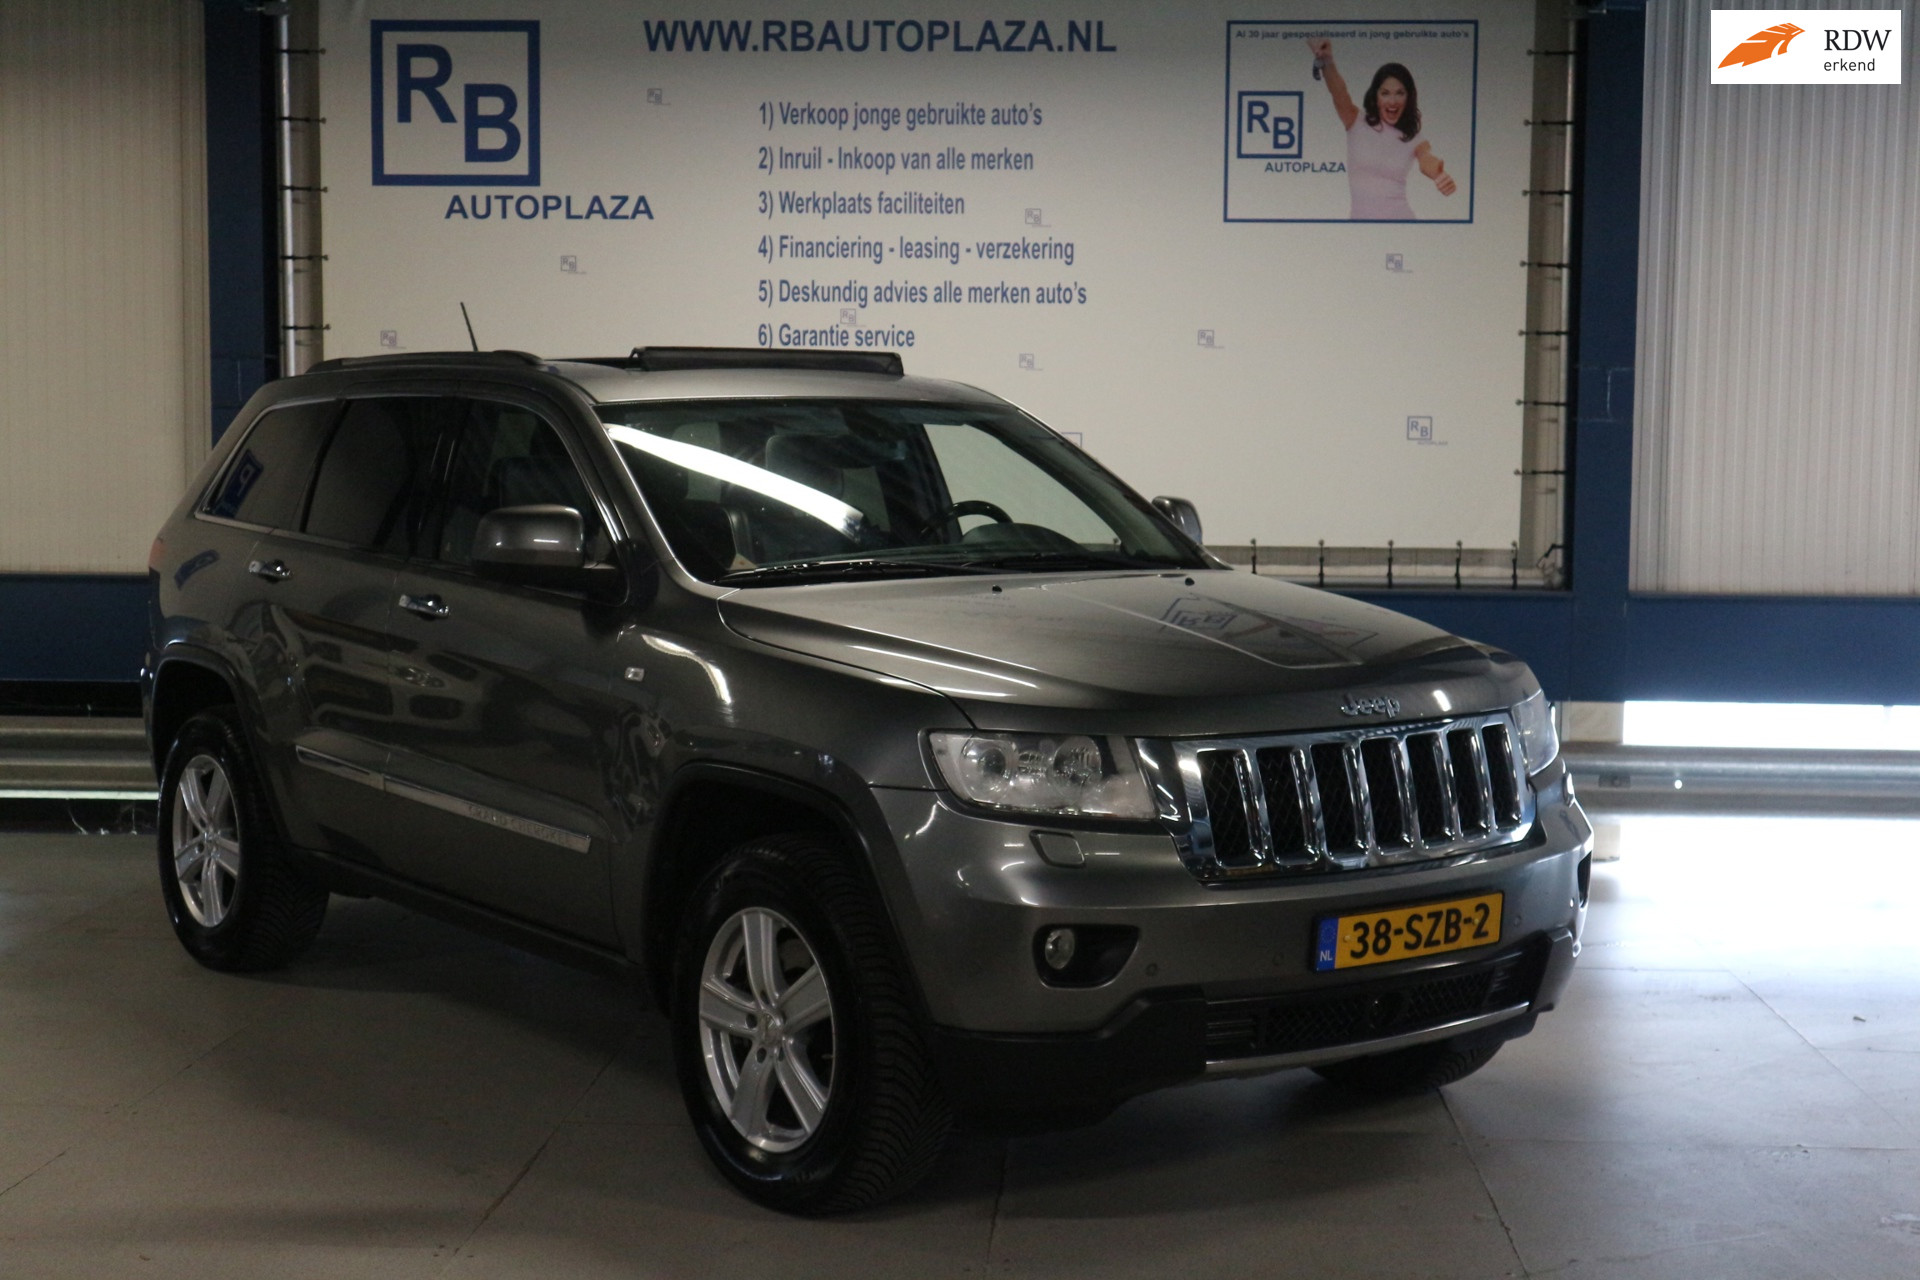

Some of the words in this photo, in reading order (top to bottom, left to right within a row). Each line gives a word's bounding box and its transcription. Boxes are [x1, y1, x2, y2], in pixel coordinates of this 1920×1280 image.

[644, 20, 1117, 52] WWW.RBAUTOPLAZA.NL
[397, 44, 521, 163] RB
[759, 102, 773, 131] 1)
[779, 102, 848, 130] Verkoop
[853, 102, 901, 131] jonge
[907, 102, 986, 131] gebruikte
[1247, 100, 1296, 150] RB
[759, 146, 773, 175] 2)
[779, 147, 822, 170] Inruil
[838, 147, 895, 175] Inkoop
[901, 152, 930, 170] van
[937, 147, 966, 170] alle
[971, 147, 1034, 170] merken
[1264, 161, 1346, 173] AUTOPLAZA
[445, 195, 654, 220] AUTOPLAZA
[758, 191, 773, 219] 3)
[779, 191, 872, 219] Werkplaats
[877, 191, 965, 215] faciliteiten
[758, 235, 773, 263] 4)
[779, 235, 882, 264] Financiering
[900, 236, 960, 265] leasing
[976, 236, 1075, 266] verzekering
[758, 280, 773, 307] 5)
[779, 280, 868, 308] Deskundig
[874, 280, 928, 303] advies
[934, 281, 963, 303] alle
[969, 281, 1030, 304] merken
[758, 324, 773, 348] 6)
[779, 324, 850, 347] Garantie
[855, 325, 915, 347] service
[1341, 697, 1400, 718] Jeep
[1349, 902, 1491, 958] 38-SZB-2
[1319, 949, 1333, 962] NL
